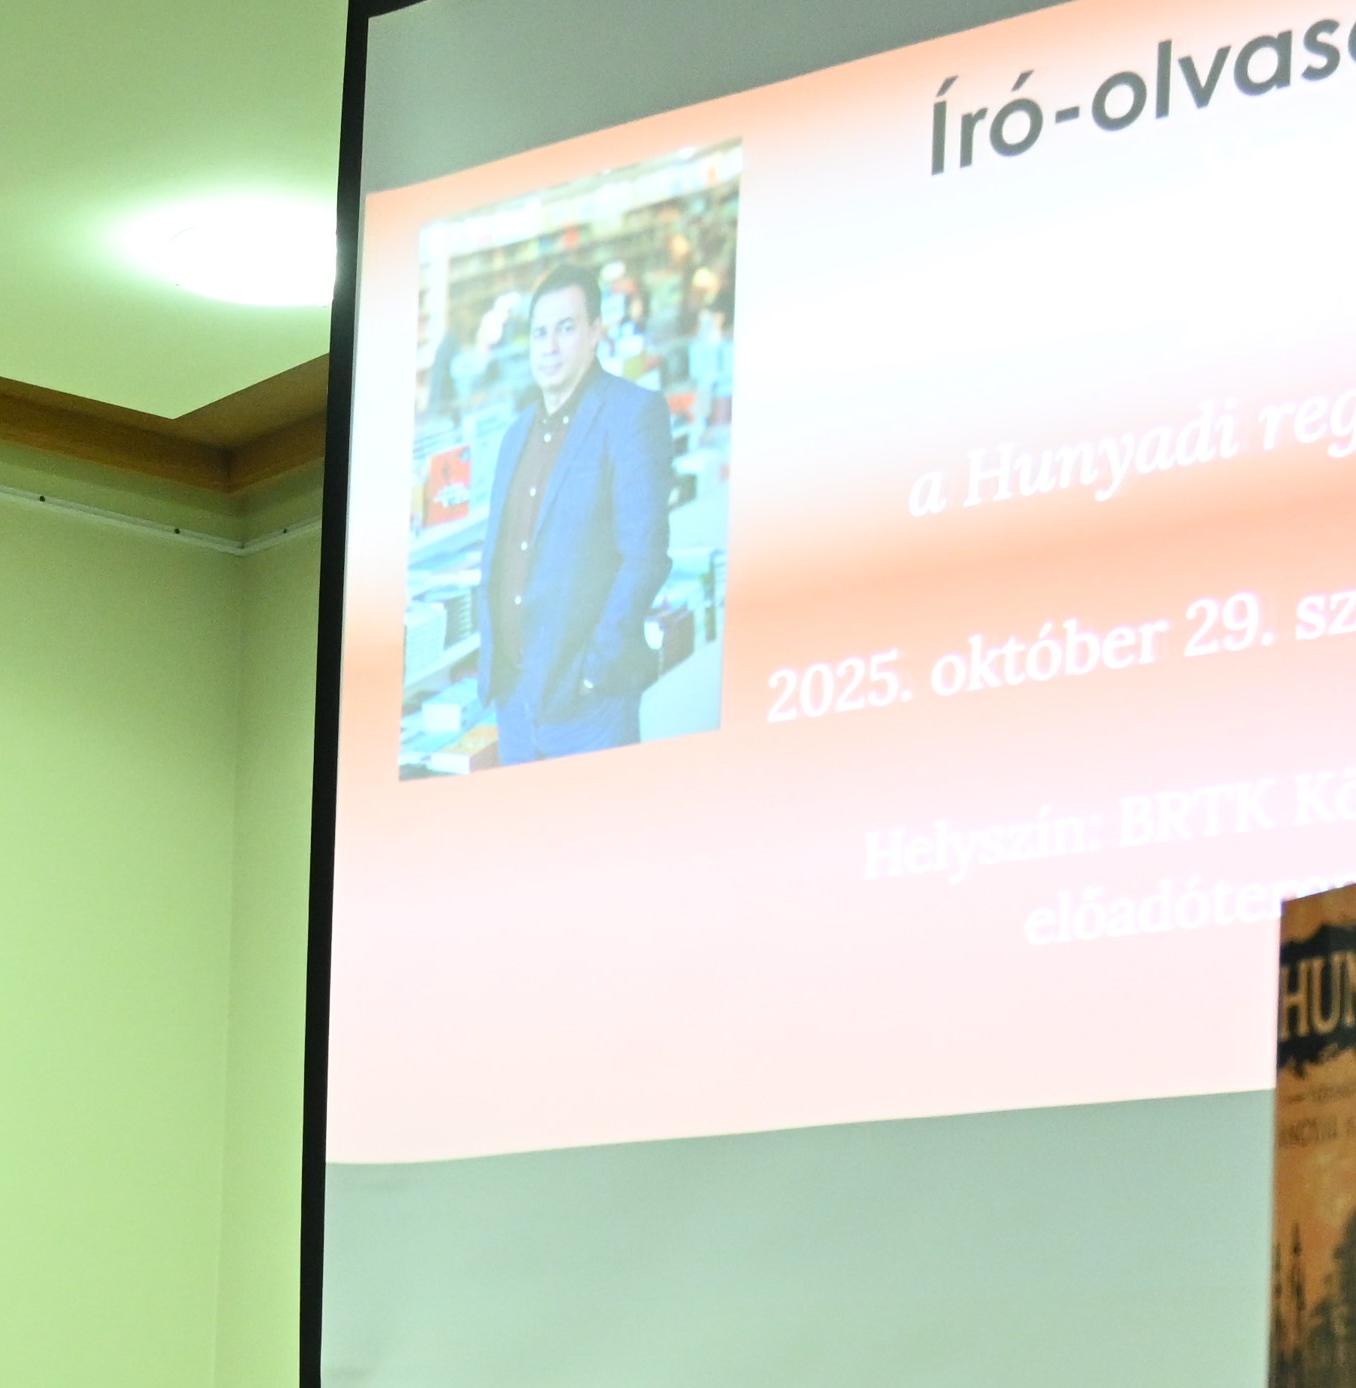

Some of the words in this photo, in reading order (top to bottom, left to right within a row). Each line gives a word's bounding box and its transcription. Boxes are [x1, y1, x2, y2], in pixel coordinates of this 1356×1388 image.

[908, 466, 944, 517] a
[962, 398, 1240, 503] Hunyadi
[766, 650, 912, 723] 2025.
[929, 617, 1169, 697] október
[1183, 590, 1275, 657] 29.
[863, 804, 1102, 885] Helyszín:
[1118, 779, 1275, 847] BRTK
